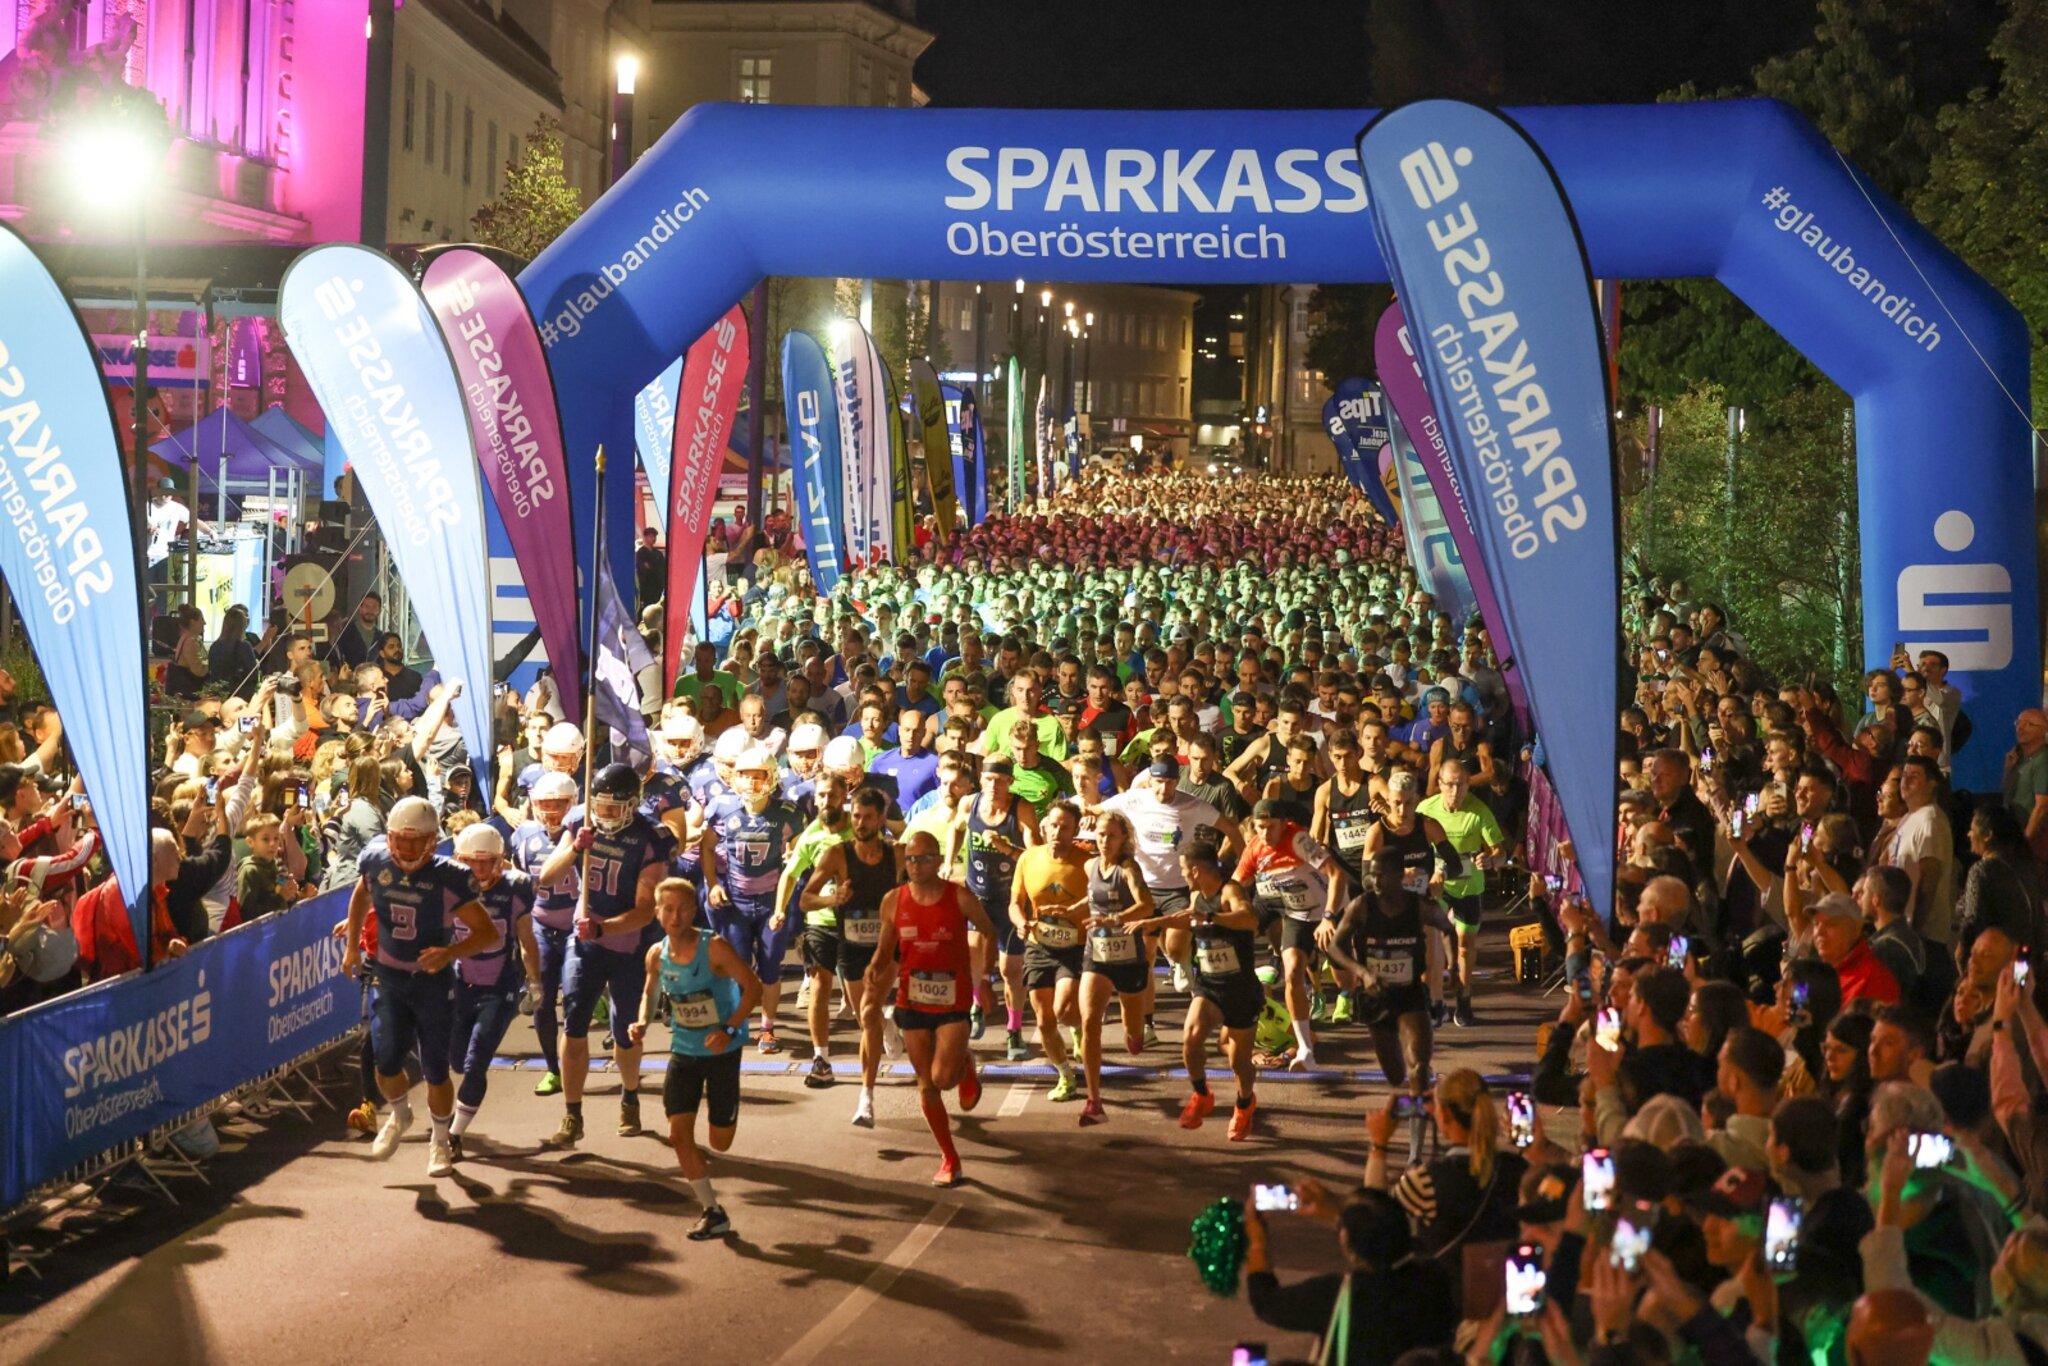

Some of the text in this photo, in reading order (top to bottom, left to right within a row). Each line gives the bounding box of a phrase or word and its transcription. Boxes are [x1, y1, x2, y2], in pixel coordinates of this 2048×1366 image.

[945, 146, 1369, 214] SPARKASS
[946, 220, 1287, 260] Oberösterreich
[538, 186, 711, 348] #glaubandich
[1760, 185, 1943, 353] #glaubandich
[676, 349, 728, 524] SPARKASSE
[688, 412, 724, 535] Oberösterreich
[1343, 828, 1366, 840] 1445
[734, 841, 771, 866] 17
[390, 904, 417, 941] 9
[853, 922, 881, 934] 1699
[1100, 940, 1127, 952] 2197
[1207, 952, 1229, 963] 441
[1375, 963, 1406, 975] 1437
[918, 983, 948, 996] 1002
[268, 988, 334, 1044] Oberösterreich
[677, 1004, 708, 1018] 1994
[64, 1000, 190, 1099] SPARKASSE
[65, 1075, 164, 1140] Oberösterreich
